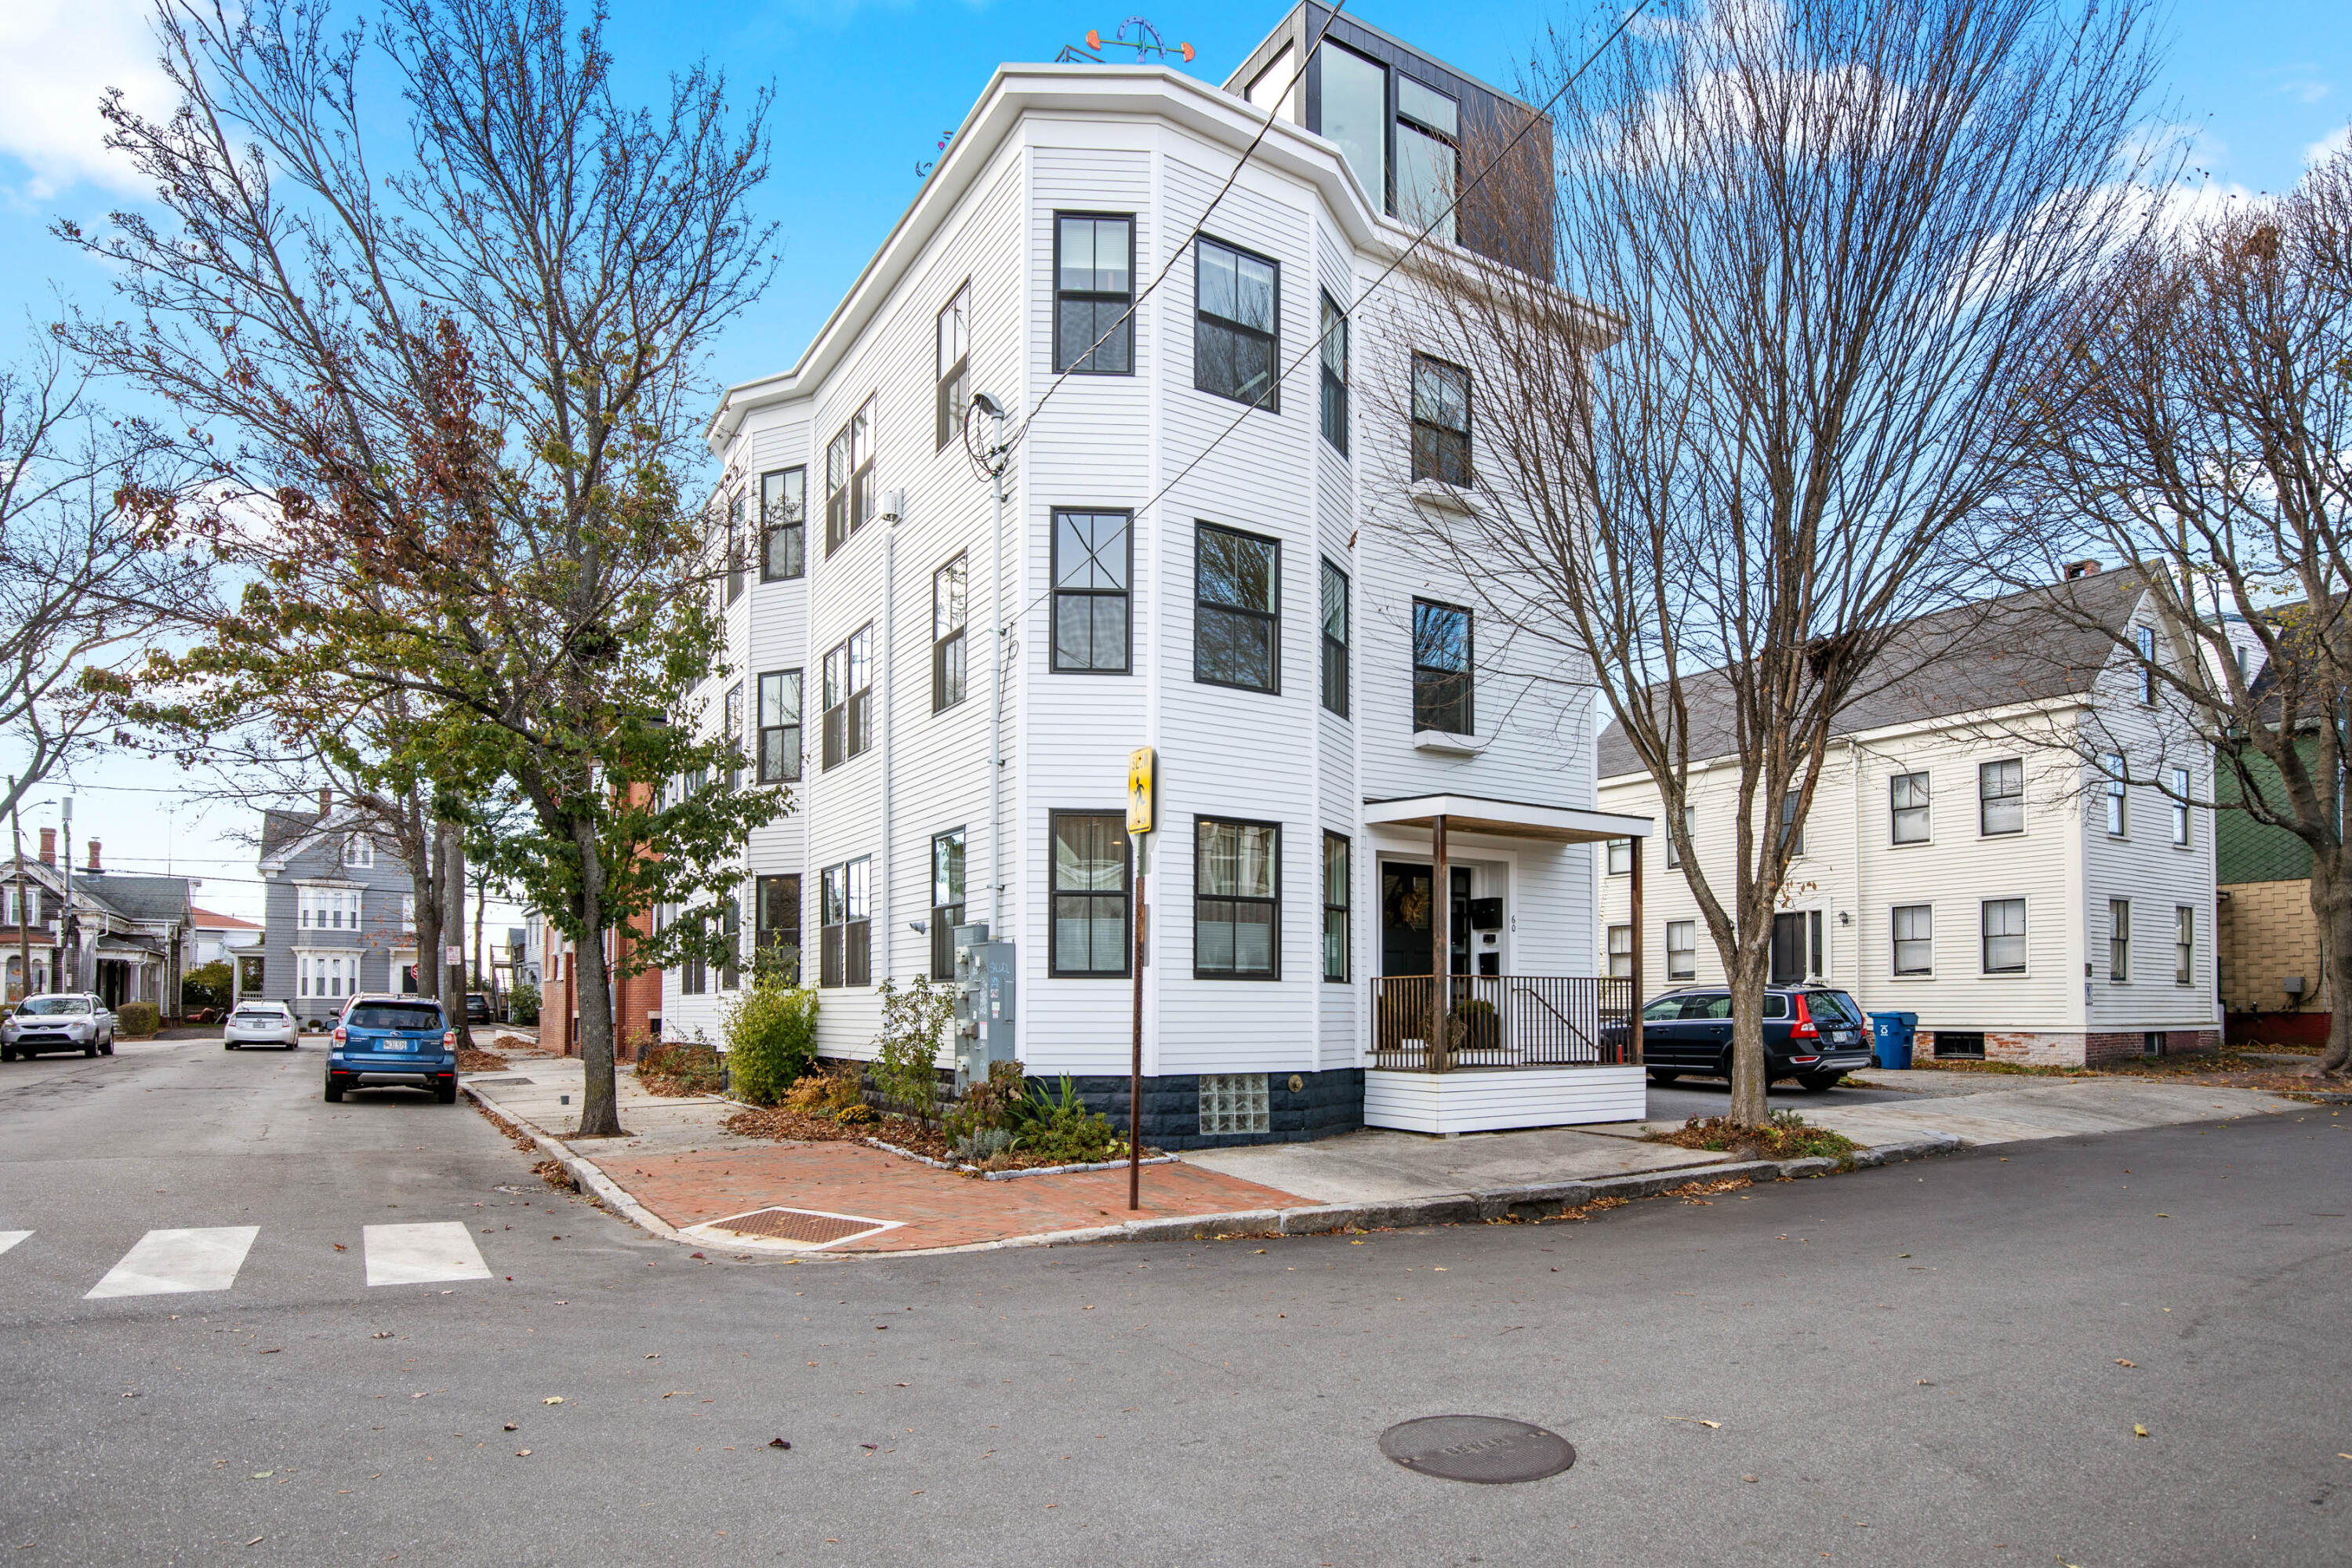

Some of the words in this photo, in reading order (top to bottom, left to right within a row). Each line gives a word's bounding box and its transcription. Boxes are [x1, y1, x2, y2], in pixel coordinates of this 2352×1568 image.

[1131, 753, 1149, 770] SLOW
[1512, 915, 1516, 932] 60
[1443, 1438, 1506, 1455] SEWER
